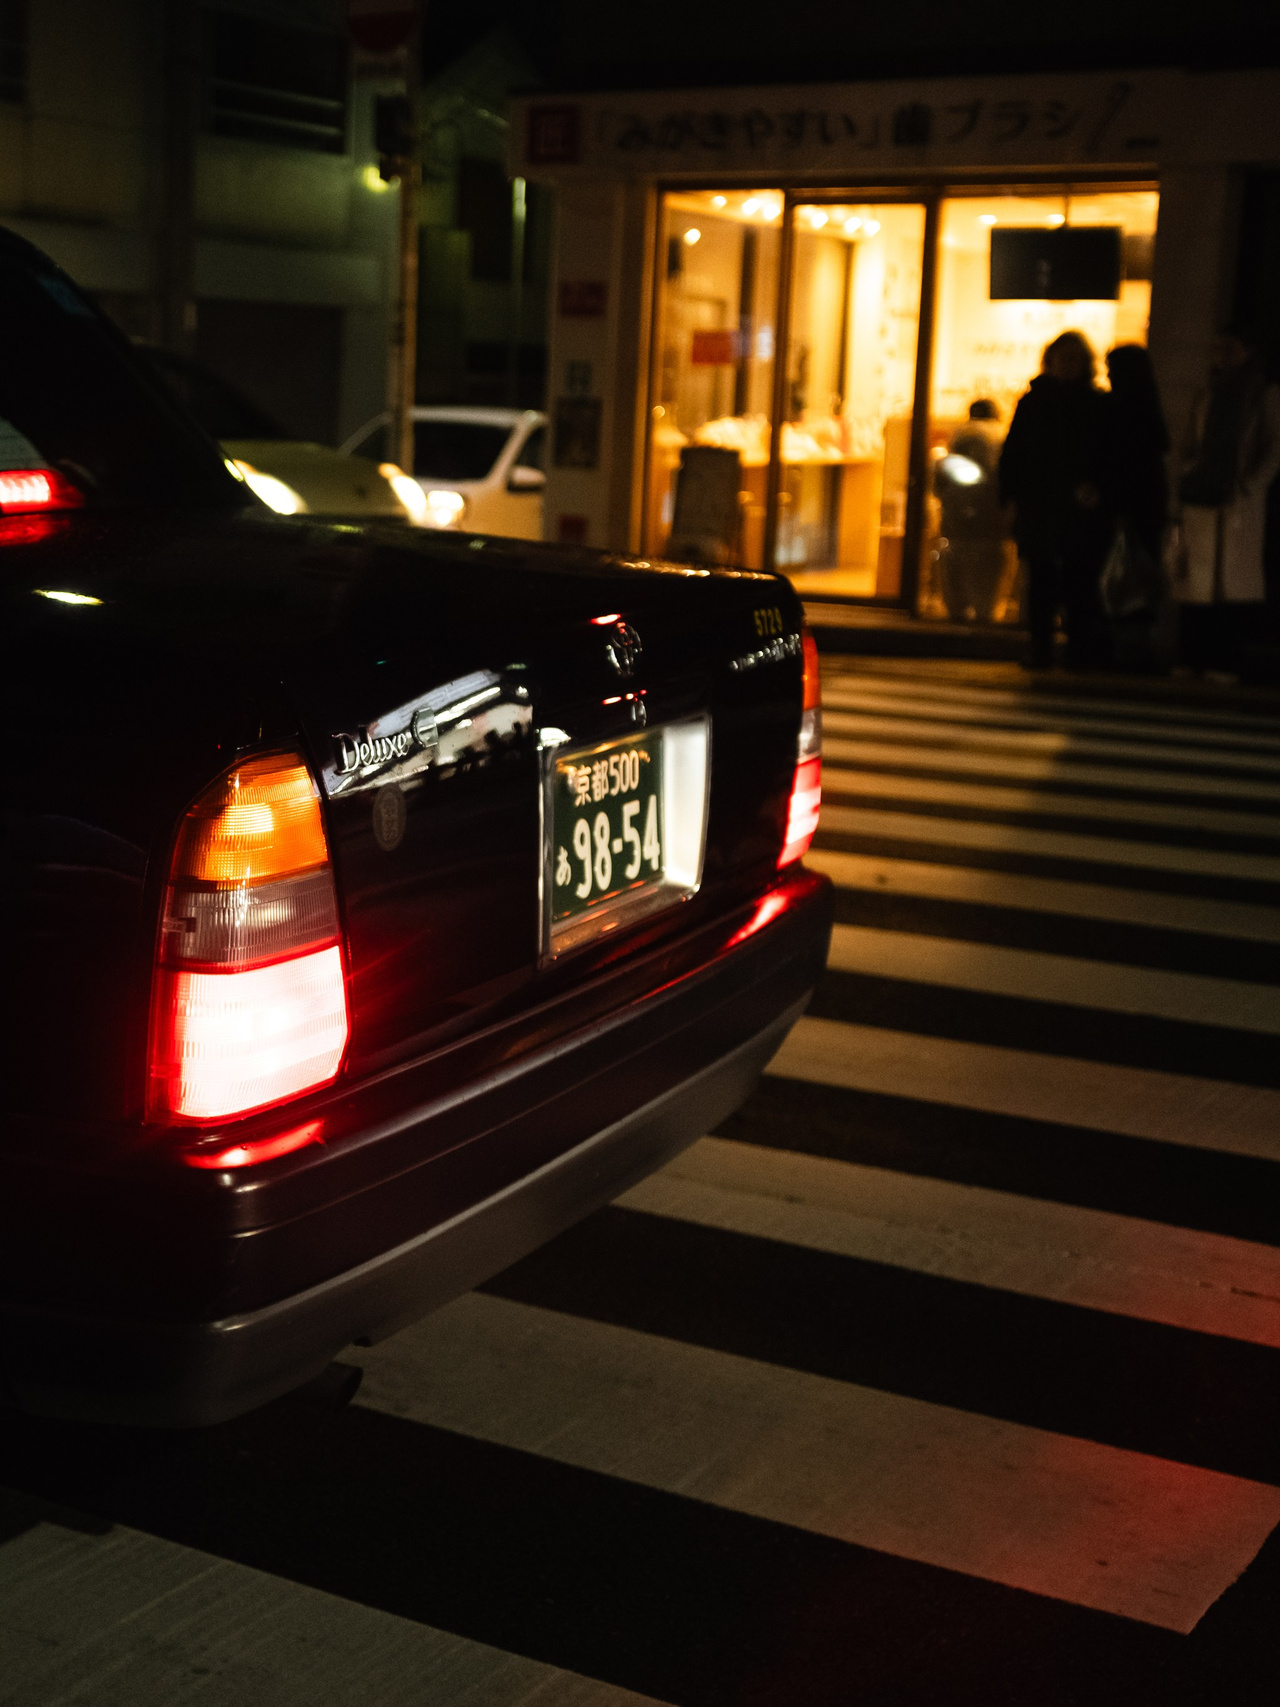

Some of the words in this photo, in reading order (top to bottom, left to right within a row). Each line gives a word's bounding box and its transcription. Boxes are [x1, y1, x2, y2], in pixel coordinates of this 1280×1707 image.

[330, 724, 410, 776] Deluxe
[555, 845, 572, 887] あ
[573, 794, 661, 899] 98-54
